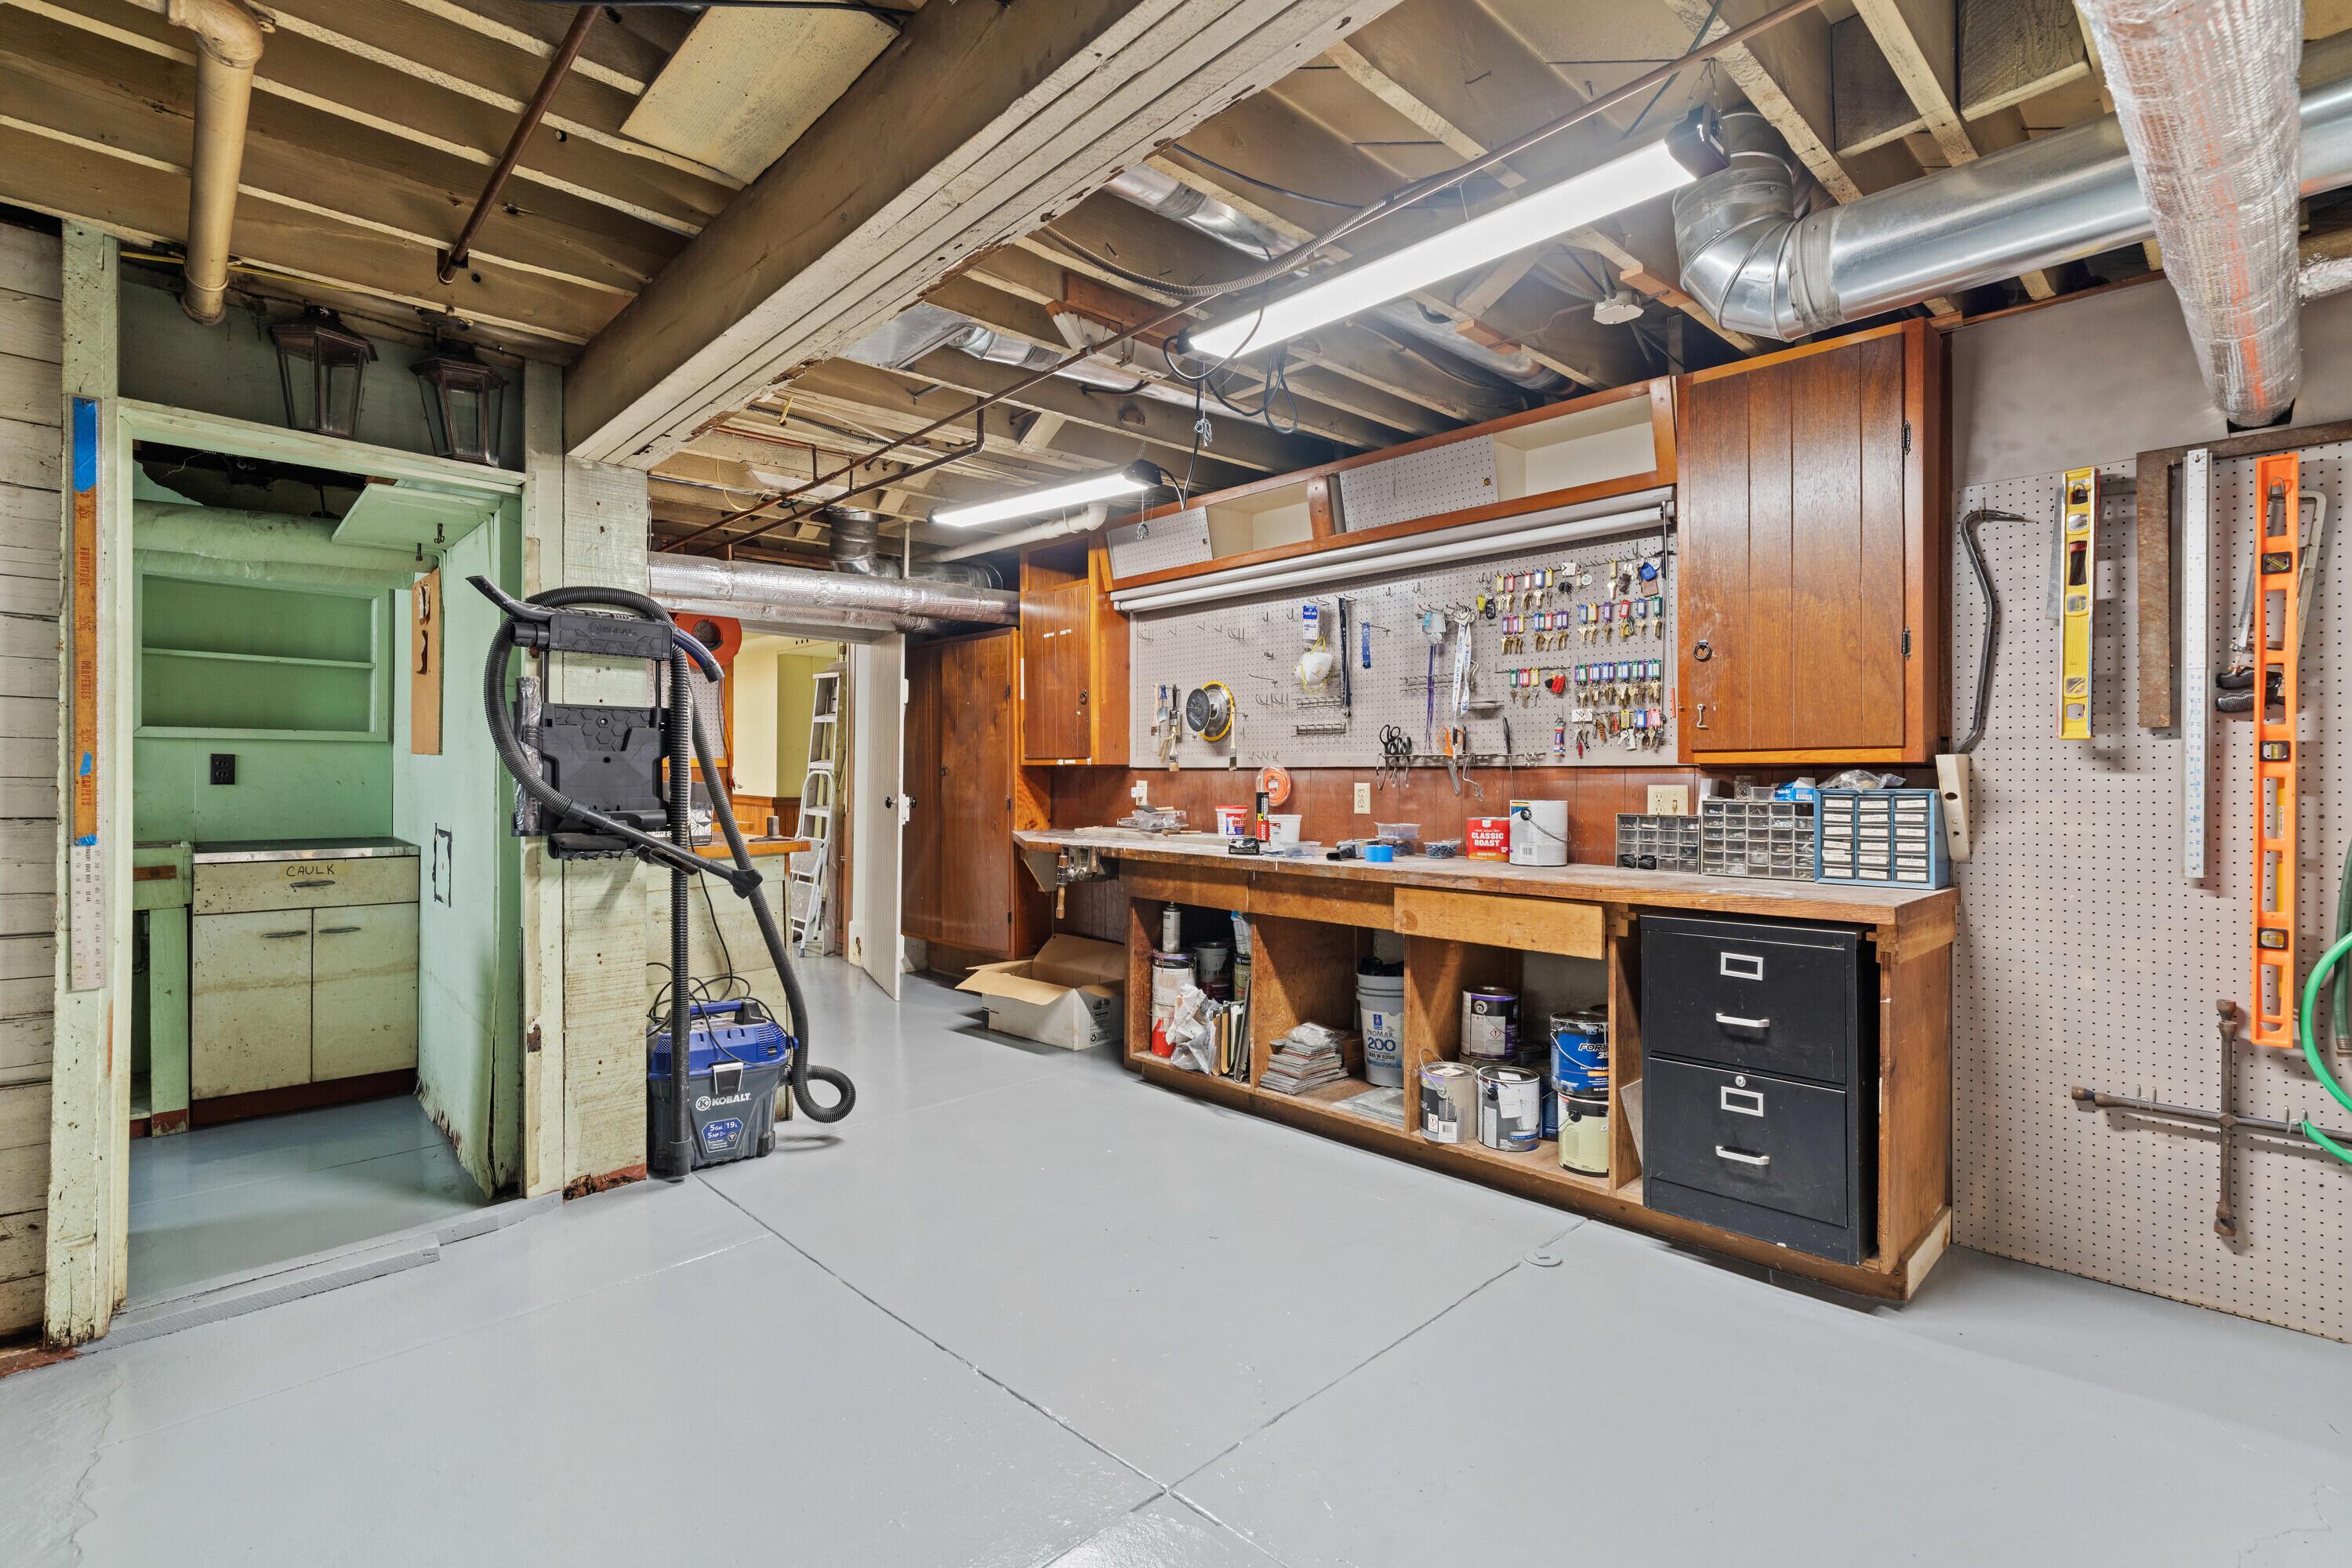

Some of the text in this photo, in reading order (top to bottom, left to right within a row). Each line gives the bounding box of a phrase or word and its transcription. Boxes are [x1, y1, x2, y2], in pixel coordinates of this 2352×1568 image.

[80, 547, 90, 587] FURNITURE
[81, 660, 93, 700] DRAPERIES
[81, 775, 92, 807] CARPETS
[286, 863, 335, 877] CAULK
[1367, 1036, 1396, 1052] 200
[711, 1093, 751, 1106] KOBALT
